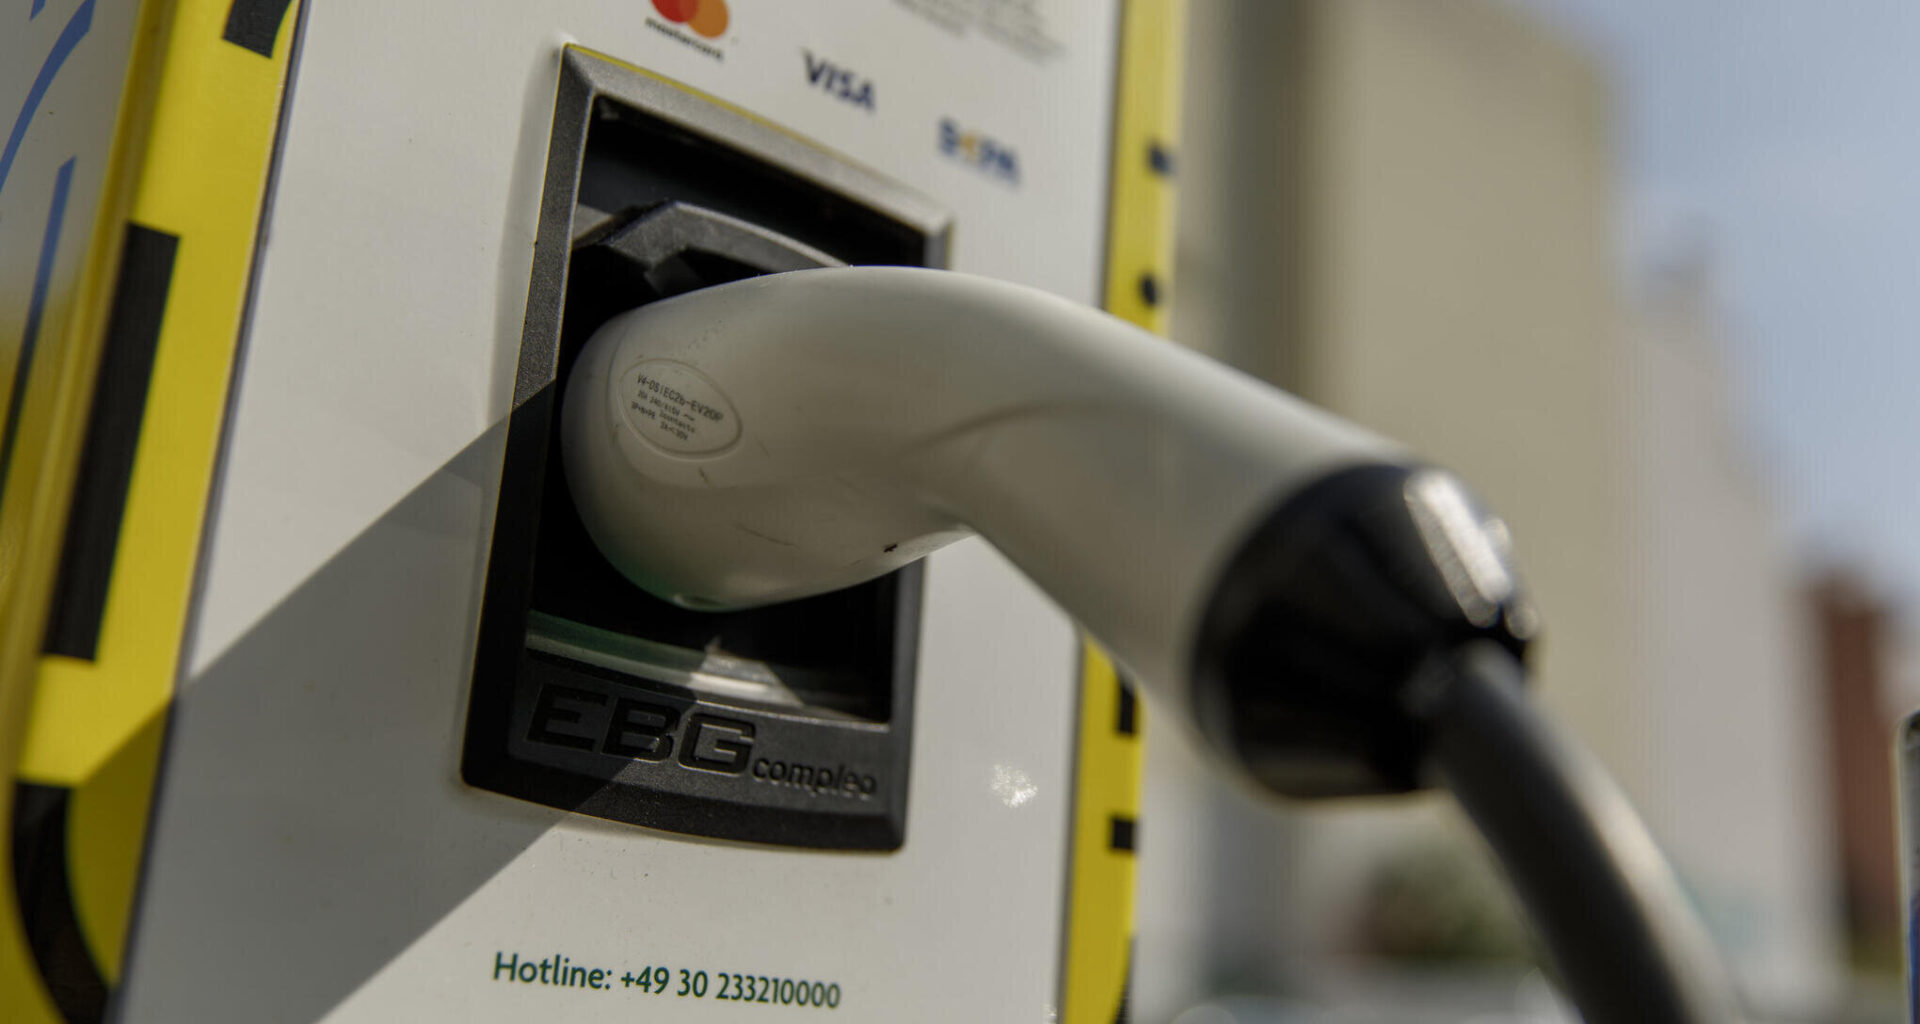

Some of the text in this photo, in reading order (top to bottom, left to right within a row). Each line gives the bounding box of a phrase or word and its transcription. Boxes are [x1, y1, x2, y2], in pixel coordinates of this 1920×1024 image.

[802, 49, 876, 113] VISA
[524, 683, 878, 799] EBG compleo
[491, 951, 842, 1010] Hotline: +49 30 233210000
